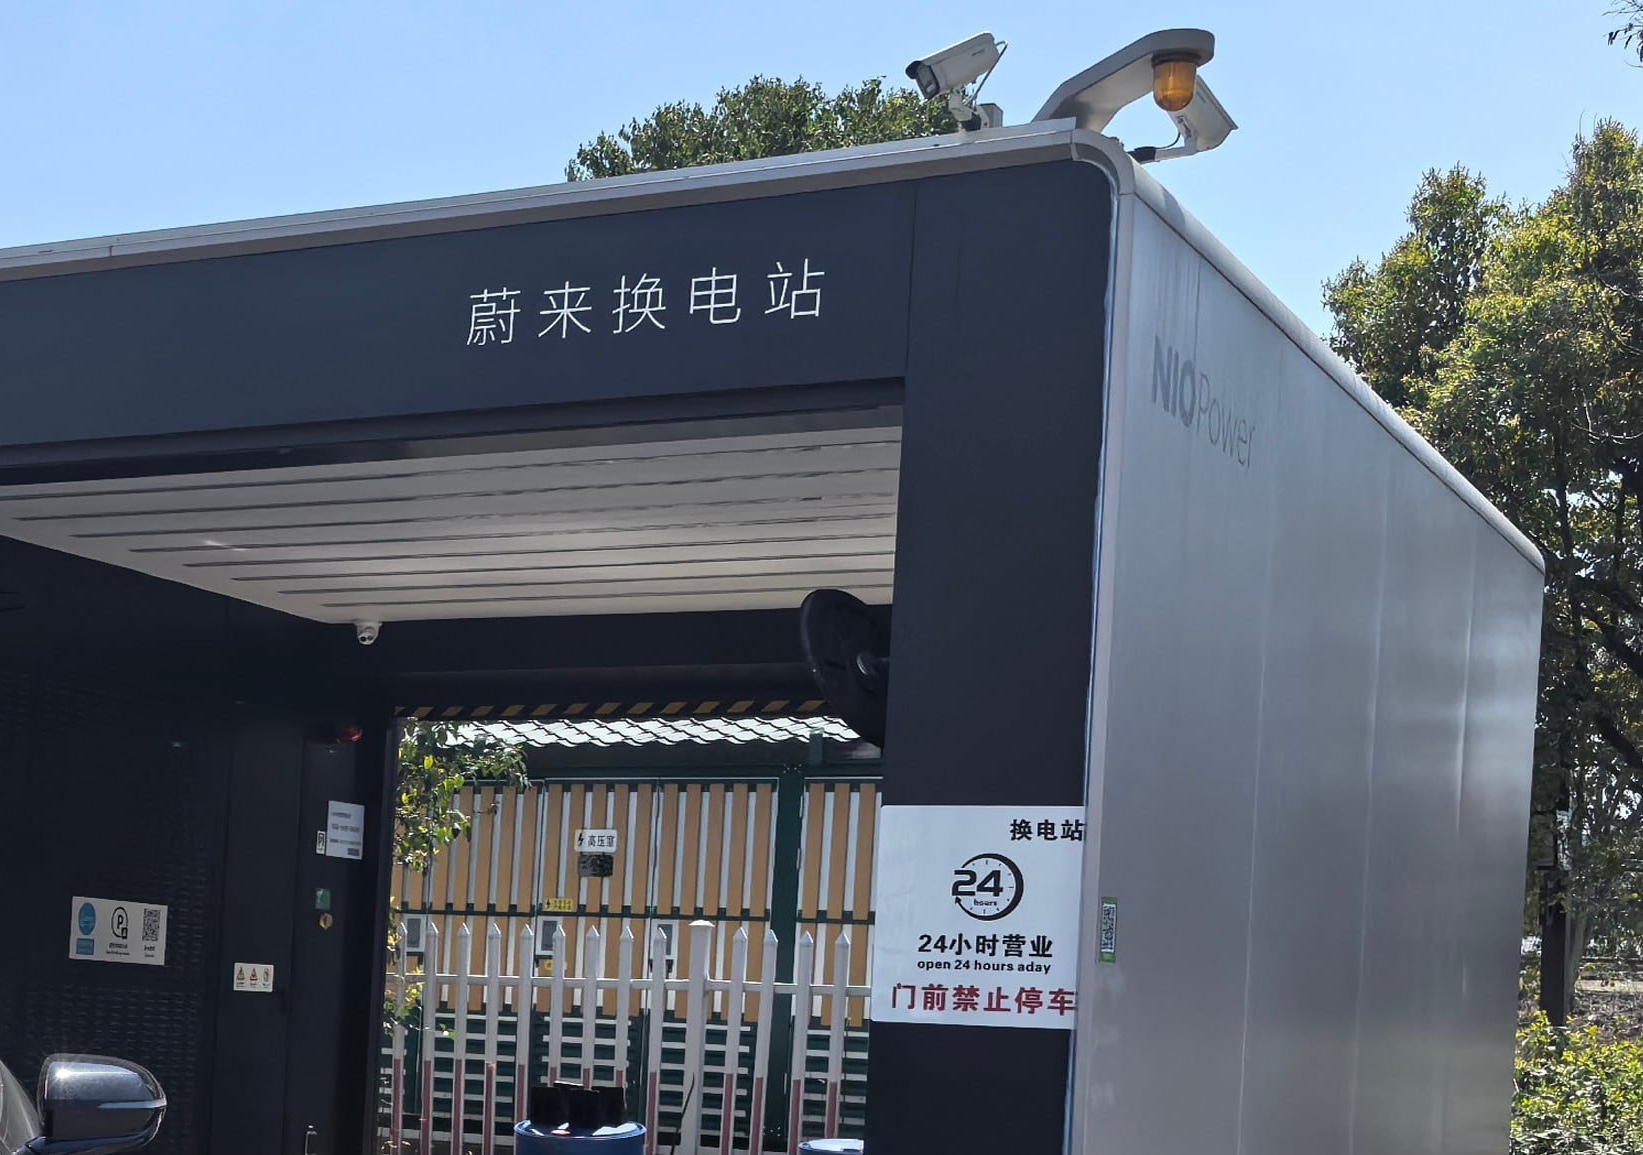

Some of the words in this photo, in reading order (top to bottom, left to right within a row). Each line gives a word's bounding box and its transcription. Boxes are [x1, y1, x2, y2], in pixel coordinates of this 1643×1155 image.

[466, 258, 825, 346] 蔚来换电站
[1009, 819, 1086, 842] 换电站
[951, 869, 1004, 897] 24
[973, 898, 998, 907] hours
[917, 932, 1054, 958] 24小时营业
[917, 961, 951, 971] open
[954, 959, 971, 971] 24
[974, 960, 1014, 972] hours
[1017, 961, 1052, 975] aday
[891, 982, 1078, 1017] 门前禁止停车
